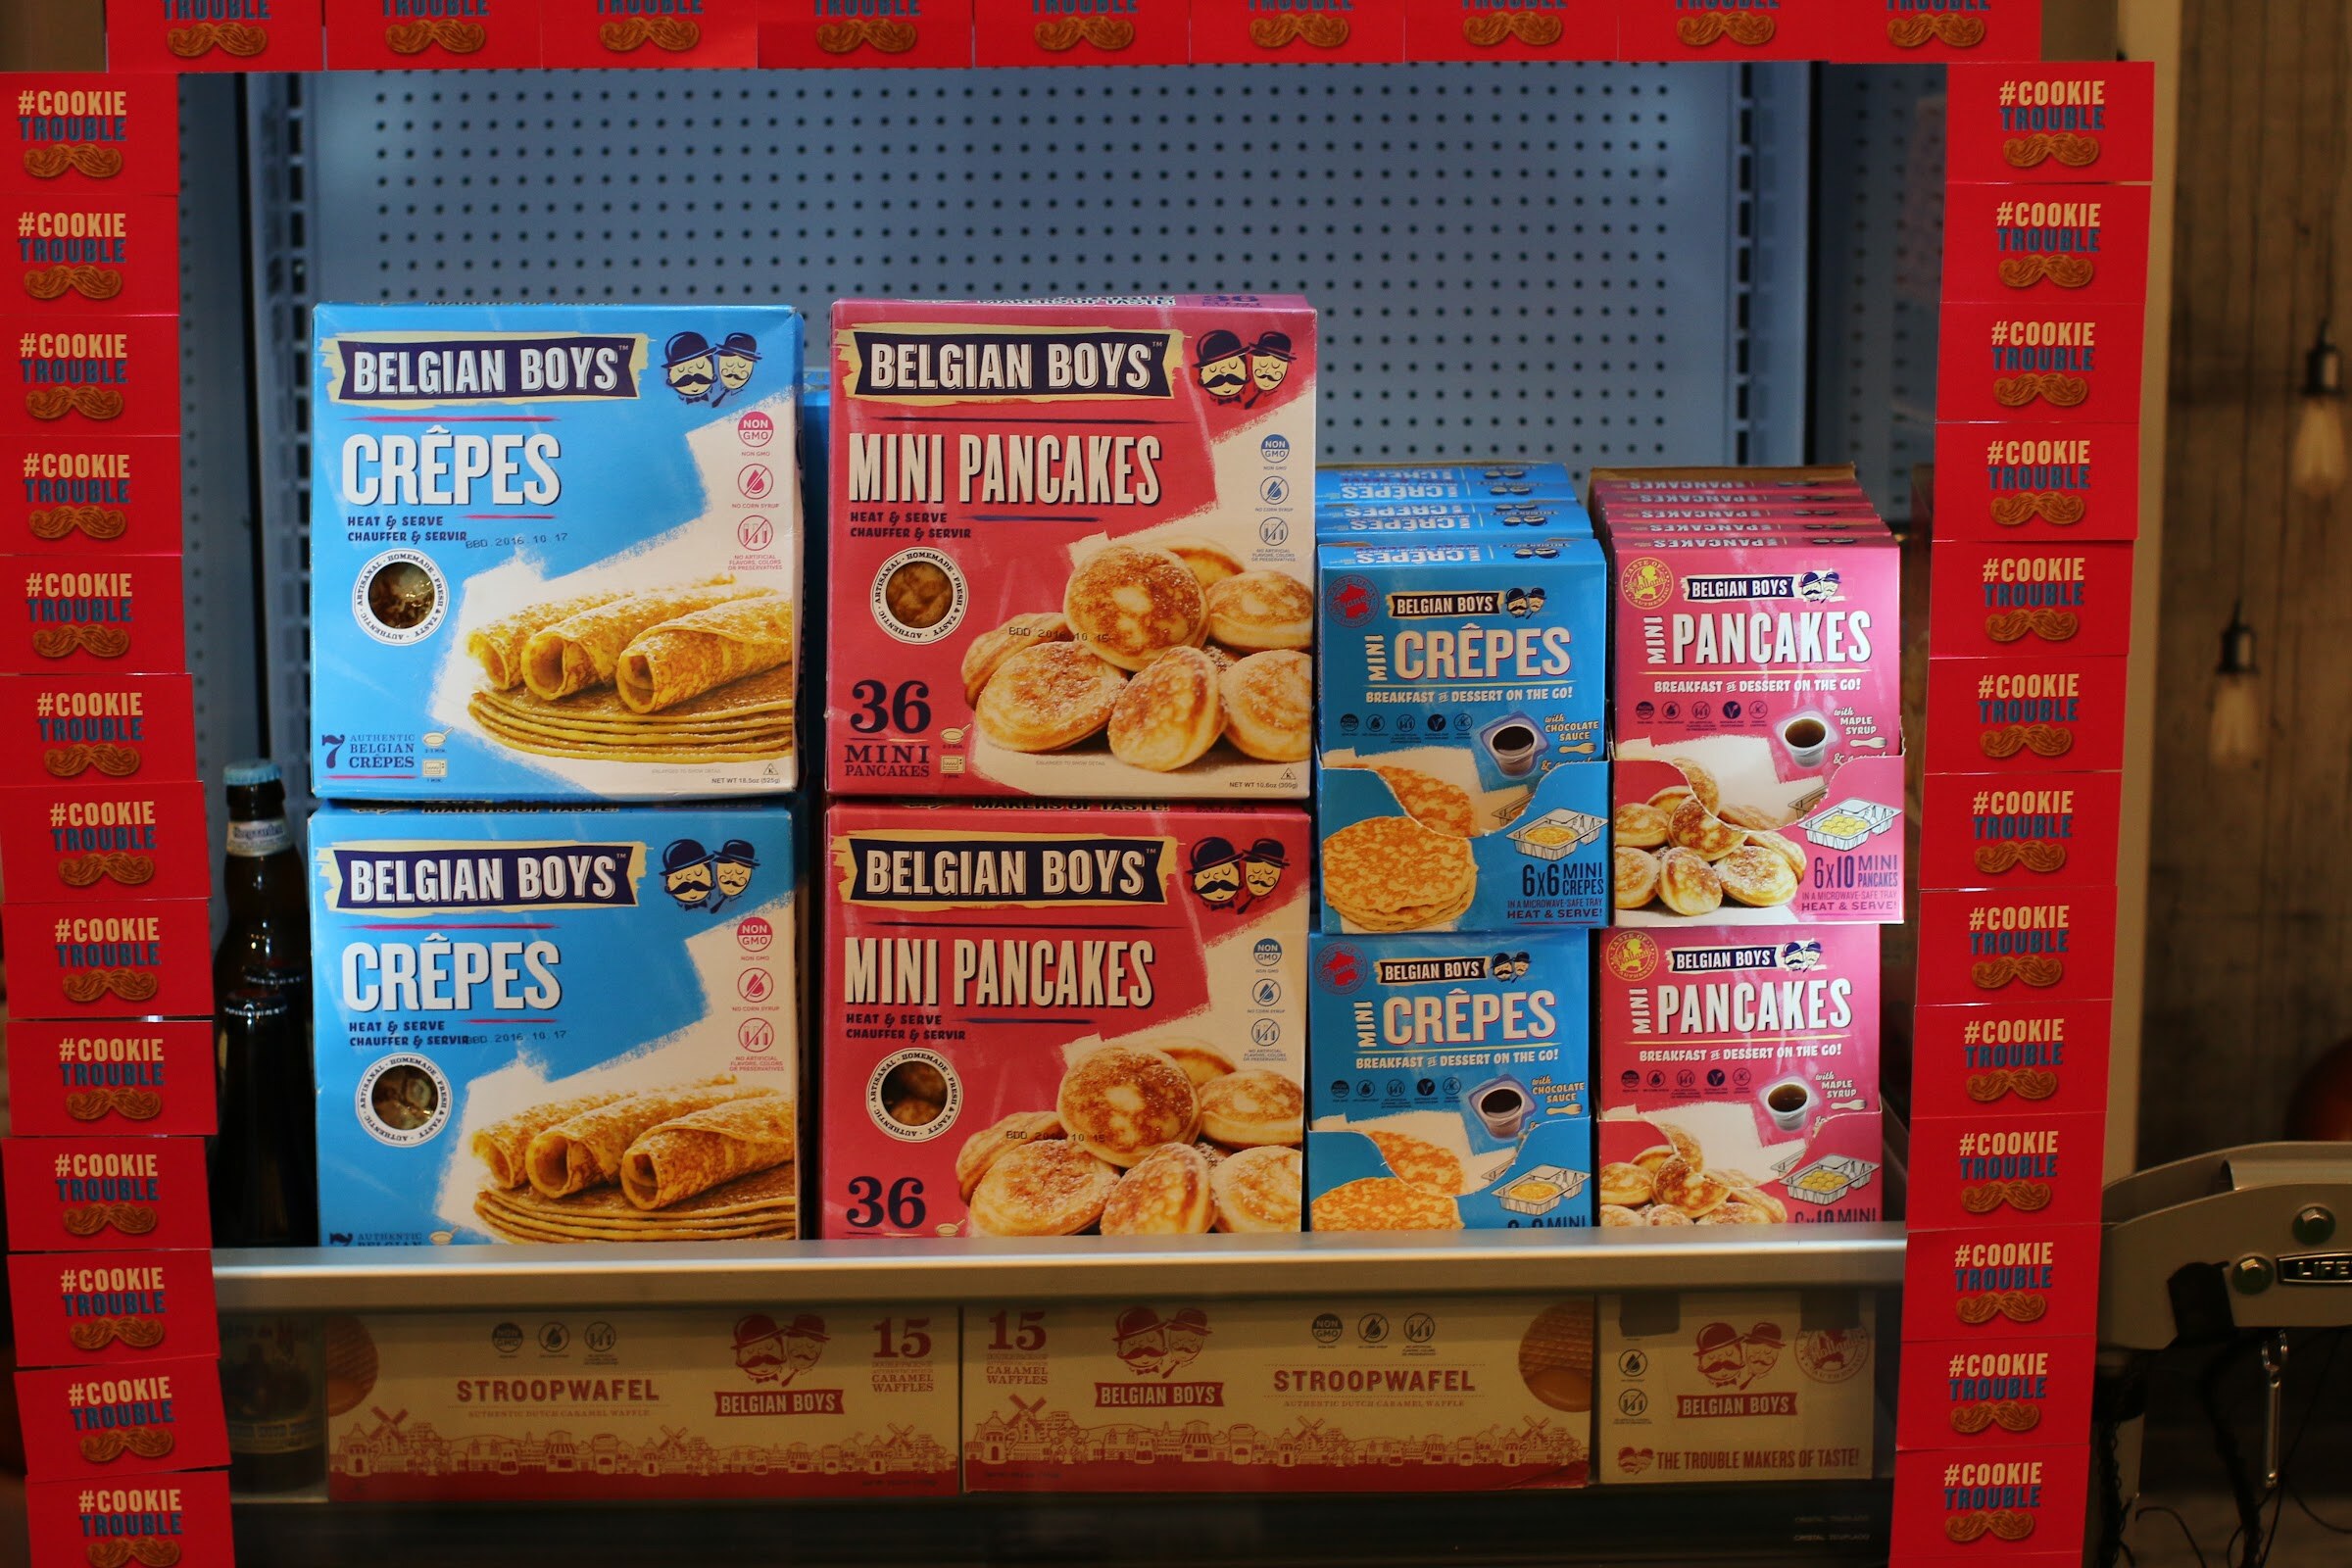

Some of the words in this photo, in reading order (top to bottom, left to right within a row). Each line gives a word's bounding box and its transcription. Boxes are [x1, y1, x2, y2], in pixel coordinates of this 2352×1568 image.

[19, 90, 126, 116] #COOKIE
[18, 117, 127, 141] TROUBLE
[1996, 201, 2101, 227] #COOKIE
[1996, 227, 2100, 252] TROUBLE
[20, 333, 127, 359] #COOKIE
[20, 359, 128, 383] TROUBLE
[354, 349, 506, 395] BELGIAN
[870, 343, 1031, 391] BELGIAN
[743, 419, 768, 428] NON
[743, 431, 768, 440] GMO
[1986, 440, 2090, 465] #COOKIE
[343, 424, 561, 506] CRÊPES
[849, 433, 945, 504] MINI
[958, 433, 1162, 506] PANCAKES
[1986, 466, 2090, 490] TROUBLE
[348, 515, 380, 526] HEAT
[386, 515, 397, 529] &
[402, 515, 443, 526] SERVE
[348, 531, 407, 542] CHAUFFER
[412, 531, 421, 545] &
[425, 531, 466, 542] SERVIR
[388, 553, 435, 573] HOMEMADE
[1624, 560, 1649, 578] TASTE
[1651, 560, 1663, 569] OF
[25, 572, 132, 598] #COOKIE
[357, 561, 383, 606] ARTISANAL
[434, 577, 444, 607] FRESH
[1691, 581, 1747, 598] BELGIAN
[1751, 579, 1788, 596] BOYS
[26, 599, 133, 622] TROUBLE
[1396, 597, 1453, 615] BELGIAN
[1457, 596, 1494, 612] BOYS
[361, 612, 404, 640] AUTHENTIC
[415, 616, 438, 637] TASTY
[1673, 611, 1872, 664] PANCAKES
[1394, 622, 1571, 679] CRÊPES
[1643, 616, 1667, 664] MINI
[1364, 635, 1388, 681] MINI
[1366, 692, 1434, 703] BREAKFAST
[1451, 690, 1502, 702] DESSERT
[1506, 690, 1523, 702] ON
[1526, 689, 1548, 700] THE
[1551, 687, 1573, 699] GO!
[1654, 680, 1723, 693] BREAKFAST
[1740, 680, 1791, 692] DESSERT
[1793, 680, 1811, 692] ON
[1814, 679, 1837, 691] THE
[1839, 678, 1862, 690] GO!
[1978, 673, 2080, 699] #COOKIE
[850, 679, 931, 735] 36
[1544, 713, 1565, 723] with
[1834, 707, 1854, 716] with
[1978, 698, 2079, 723] TROUBLE
[1544, 721, 1598, 733] CHOCOLATE
[1839, 716, 1873, 725] MAPLE
[1845, 726, 1877, 735] SYRUP
[350, 743, 415, 754] BELGIAN
[1559, 731, 1591, 742] SAUCE
[321, 734, 345, 769] 7
[349, 754, 415, 768] CRÊPES
[845, 745, 930, 763] MINI
[845, 765, 930, 777] PANCAKES
[50, 801, 156, 827] #COOKIE
[50, 826, 157, 852] TROUBLE
[866, 850, 1026, 897] BELGIAN
[1563, 862, 1602, 879] MINI
[1858, 855, 1897, 871] MINI
[350, 858, 504, 903] BELGIAN
[1562, 878, 1604, 896] CREPES
[1858, 872, 1898, 888] PANCAKES
[1507, 900, 1515, 908] IN
[1524, 899, 1584, 908] MICROWAVE-SAFE
[1586, 898, 1602, 906] TRAY
[1507, 909, 1541, 918] HEAT
[1557, 908, 1602, 917] SERVE!
[1969, 906, 2070, 931] #COOKIE
[1969, 930, 2069, 956] TROUBLE
[1385, 963, 1440, 981] BELGIAN
[1444, 961, 1480, 978] BOYS
[1676, 951, 1731, 969] BELGIAN
[1736, 950, 1771, 966] BOYS
[342, 932, 563, 1012] CRÊPES
[844, 937, 938, 1005] MINI
[953, 939, 1155, 1008] PANCAKES
[1383, 988, 1556, 1046] CRÊPES
[1629, 988, 1651, 1035] MINI
[1657, 978, 1852, 1035] PANCAKES
[1353, 1001, 1377, 1048] MINI
[59, 1039, 164, 1062] #COOKIE
[59, 1063, 165, 1087] TROUBLE
[1959, 1130, 2058, 1156] #COOKIE
[1960, 1155, 2057, 1180] TROUBLE
[847, 1176, 927, 1229] 36
[61, 1267, 165, 1293] #COOKIE
[62, 1292, 167, 1317] TROUBLE
[872, 1317, 932, 1358] 15
[988, 1309, 1047, 1351] 15
[1949, 1352, 2048, 1378] #COOKIE
[457, 1379, 660, 1402] STROOPWAFEL
[871, 1374, 933, 1383] CARAMEL
[872, 1383, 934, 1393] WAFFLES
[1274, 1369, 1476, 1392] STROOPWAFEL
[1948, 1377, 2046, 1401] TROUBLE
[721, 1395, 787, 1413] BELGIAN
[793, 1393, 835, 1412] BOYS
[1102, 1386, 1167, 1404] BELGIAN
[1173, 1386, 1215, 1404] BOYS
[1683, 1397, 1744, 1415] BELGIAN
[1750, 1396, 1789, 1413] BOYS
[1656, 1451, 1681, 1470] THE
[1685, 1450, 1740, 1469] TROUBLE
[1742, 1449, 1795, 1468] MAKERS
[1798, 1449, 1814, 1467] OF
[1817, 1447, 1859, 1467] TASTE!
[78, 1490, 182, 1513] #COOKIE
[79, 1513, 183, 1538] TROUBLE
